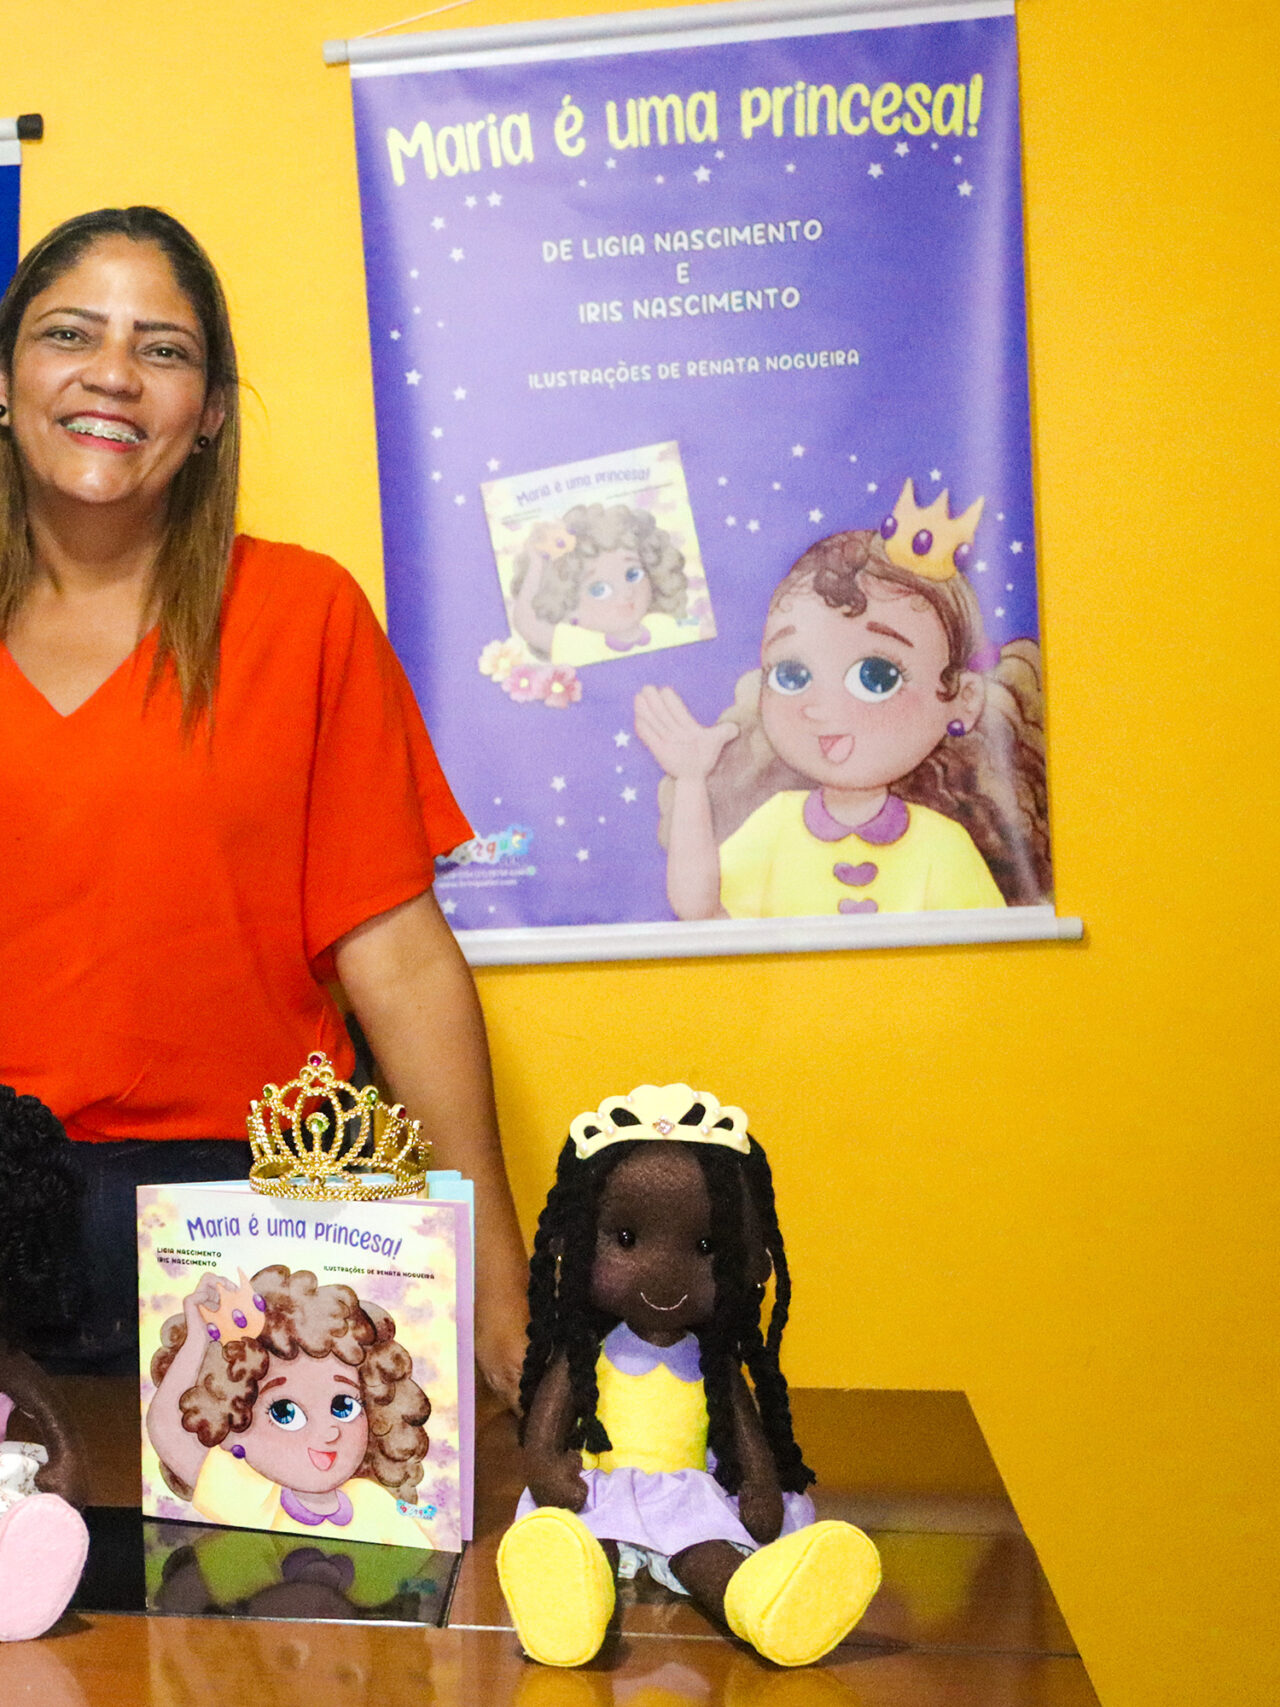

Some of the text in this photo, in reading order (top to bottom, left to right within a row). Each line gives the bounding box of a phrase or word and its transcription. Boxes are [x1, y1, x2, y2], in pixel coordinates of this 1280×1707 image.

[386, 73, 984, 187] Maria é uma princesa!
[542, 219, 823, 263] DE LIGIA NASCIMENTO
[676, 261, 691, 284] E
[579, 287, 801, 324] IRIS NASCIMENTO
[528, 349, 860, 389] ILUSTRAÇÕES DE RENATA NOGUEIRA
[516, 483, 551, 507] Maria
[566, 474, 593, 491] uma
[595, 467, 652, 486] princesa!
[176, 1249, 222, 1258] NASCIMENTO
[187, 1212, 403, 1260] Maria é uma princesa!
[171, 1258, 217, 1267] NASCIMENTO
